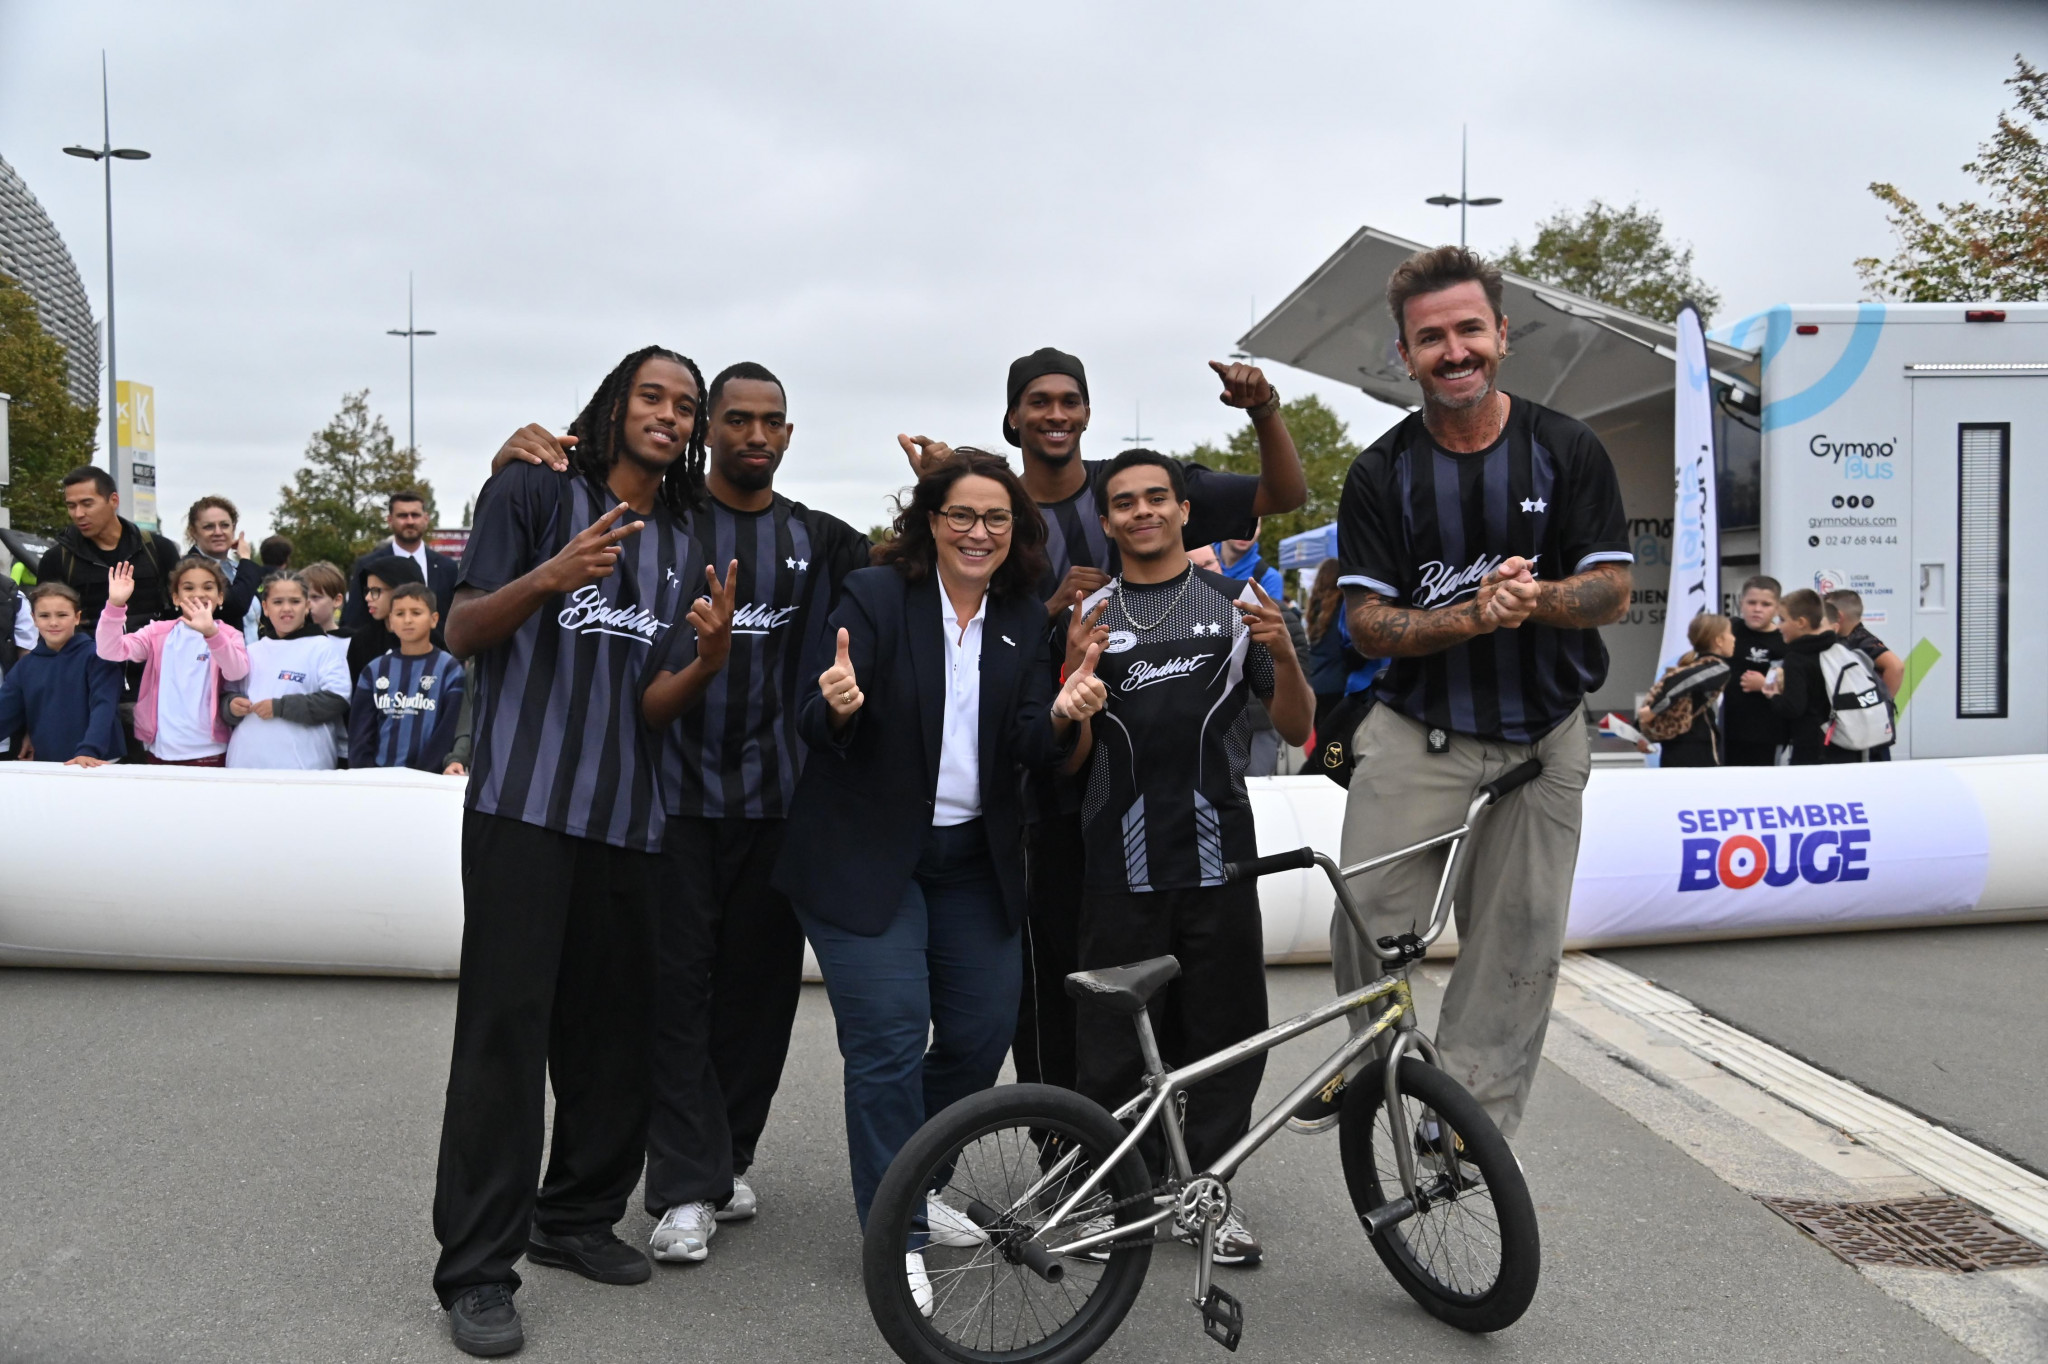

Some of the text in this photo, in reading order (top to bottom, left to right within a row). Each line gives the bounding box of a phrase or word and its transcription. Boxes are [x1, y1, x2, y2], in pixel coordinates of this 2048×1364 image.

[135, 392, 150, 436] K
[1844, 455, 1894, 479] Bus
[1808, 515, 1897, 529] gymnobus.com
[1825, 536, 1898, 546] 02 47 68 94 44
[1121, 653, 1214, 692] Blacklist
[1677, 802, 1869, 833] SEPTEMBRE
[1677, 828, 1871, 892] BOUGE
